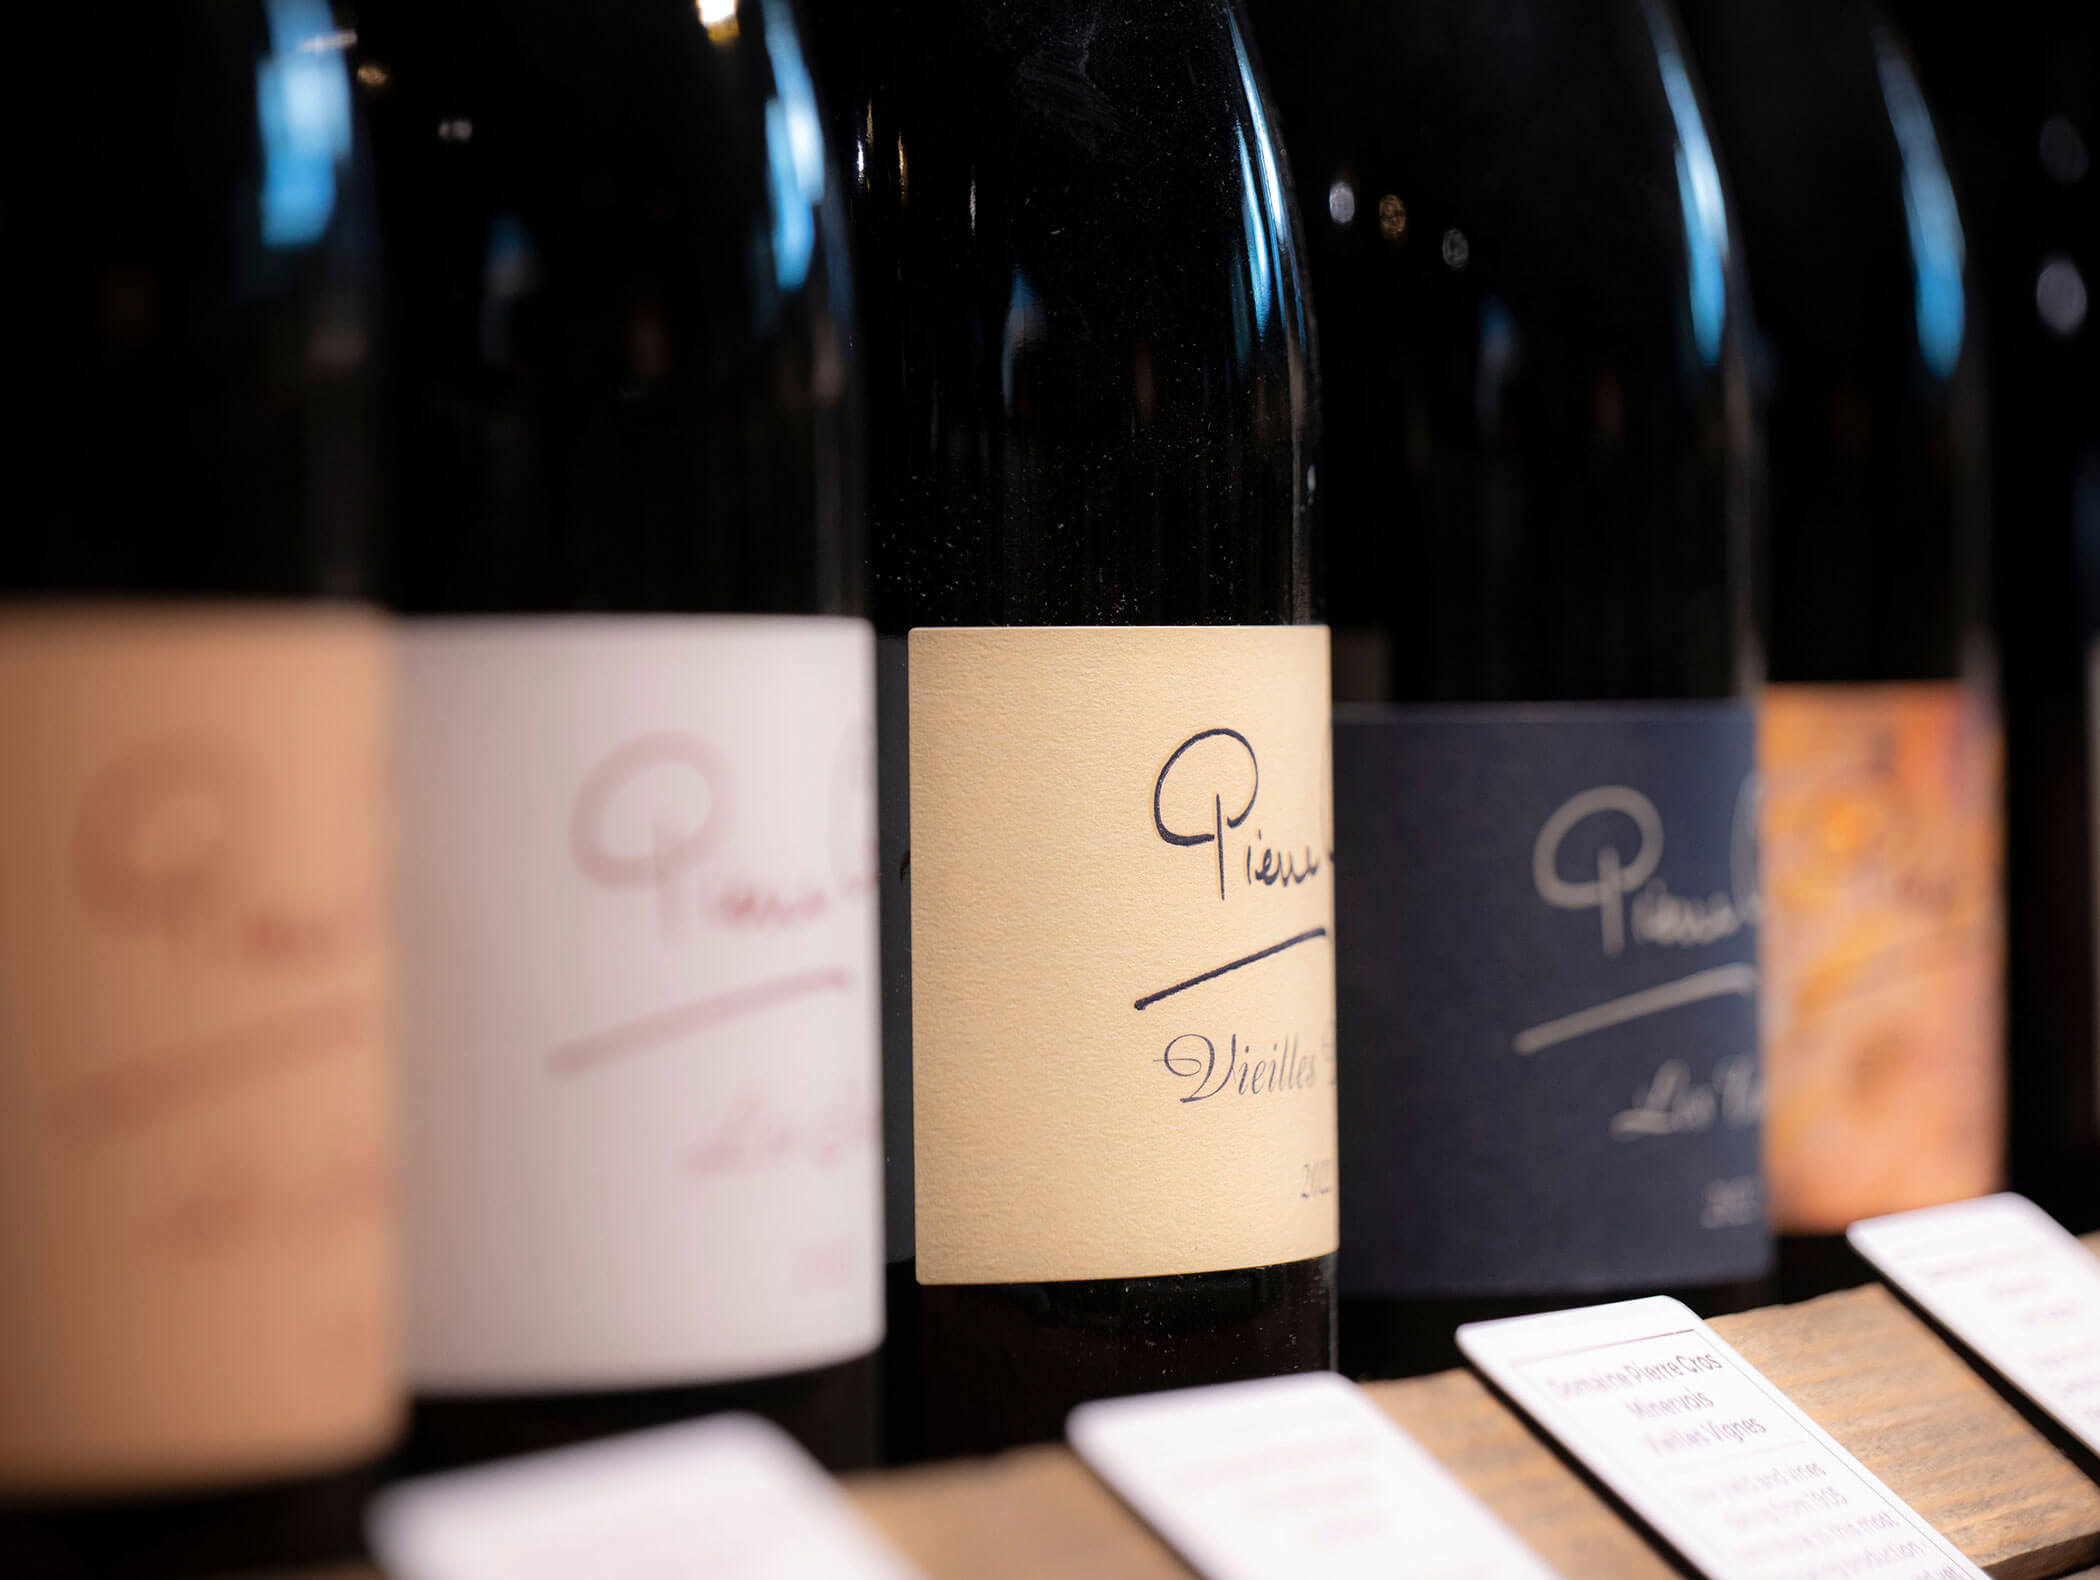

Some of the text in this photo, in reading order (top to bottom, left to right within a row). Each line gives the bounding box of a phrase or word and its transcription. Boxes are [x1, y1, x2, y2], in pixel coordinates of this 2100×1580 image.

[1153, 1033, 1317, 1104] Vieilles
[1623, 1357, 1683, 1384] Pierre
[1674, 1352, 1722, 1373] Cros
[1624, 1386, 1714, 1419] Minervois
[1704, 1416, 1767, 1443] Vignes
